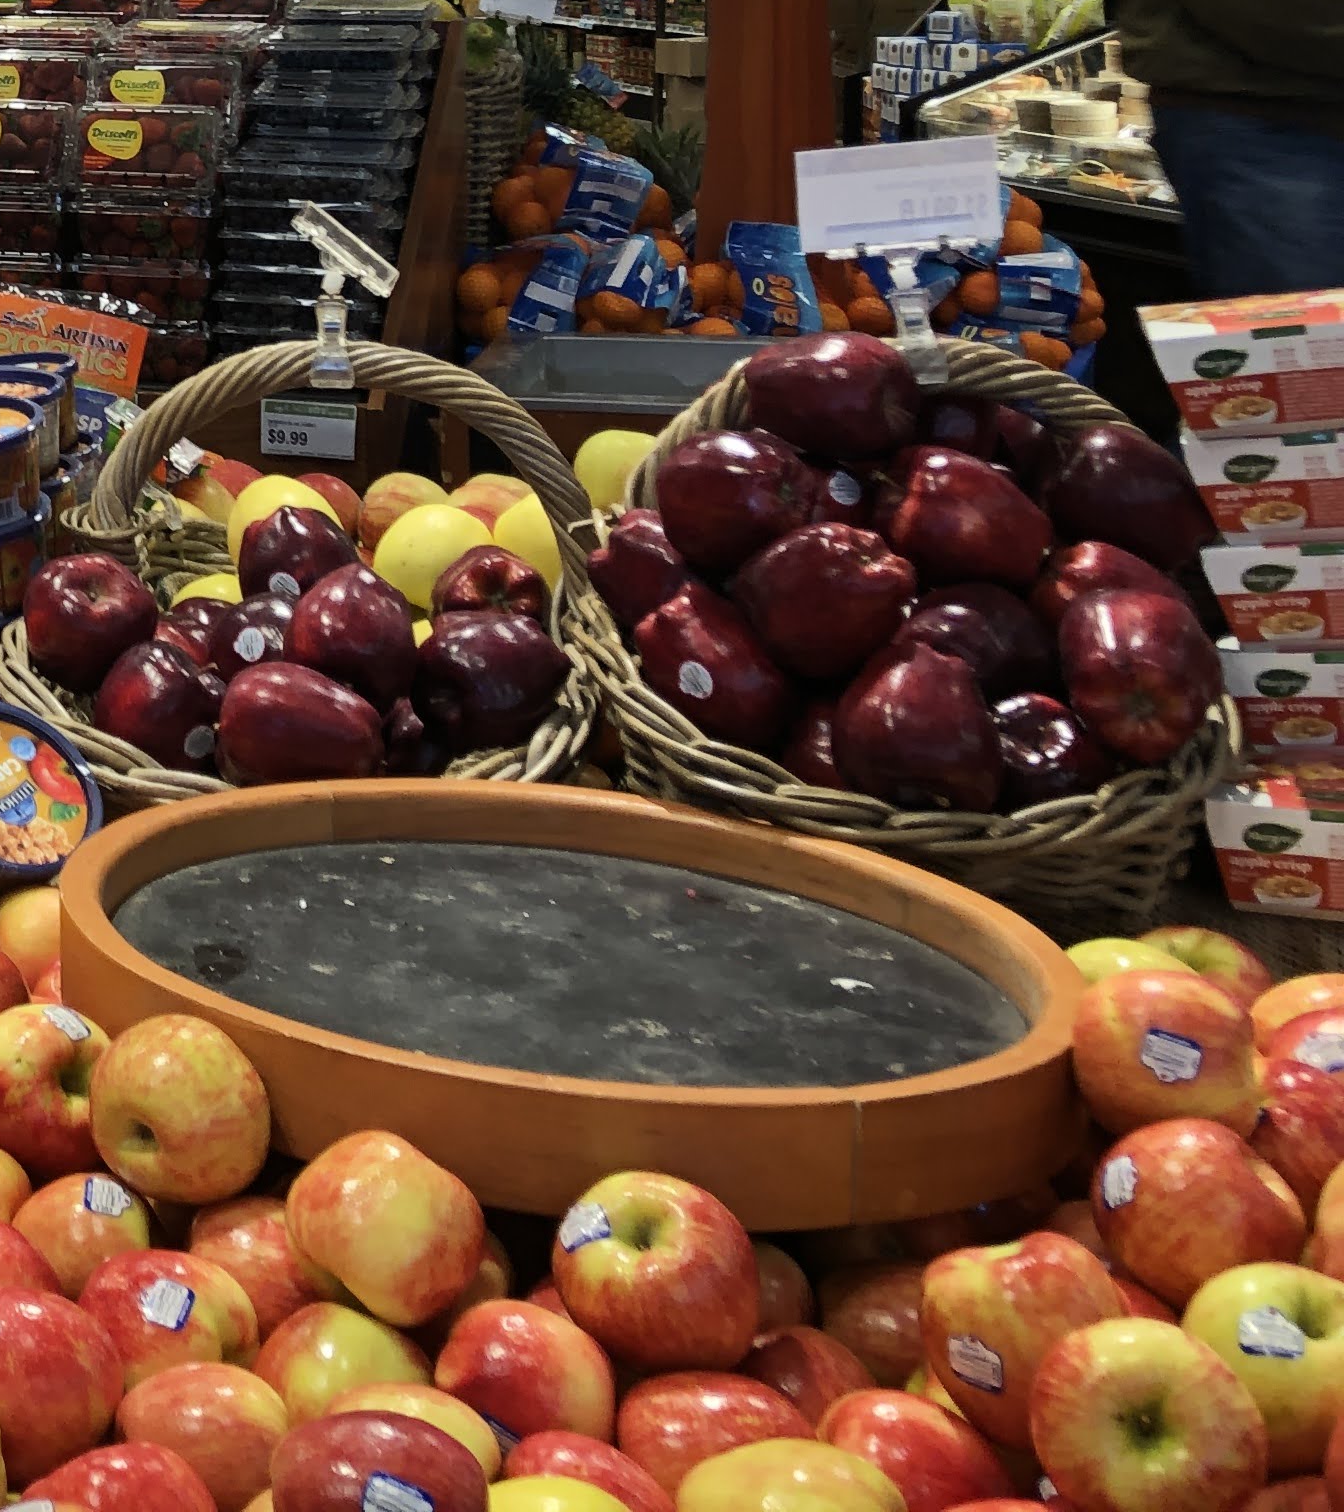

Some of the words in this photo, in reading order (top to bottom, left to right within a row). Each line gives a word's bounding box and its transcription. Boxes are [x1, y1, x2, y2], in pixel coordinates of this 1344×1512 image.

[114, 78, 160, 91] Driscoll's
[91, 126, 138, 140] Driscoll's
[53, 322, 130, 355] ARTISAN
[267, 428, 308, 447] $9.99
